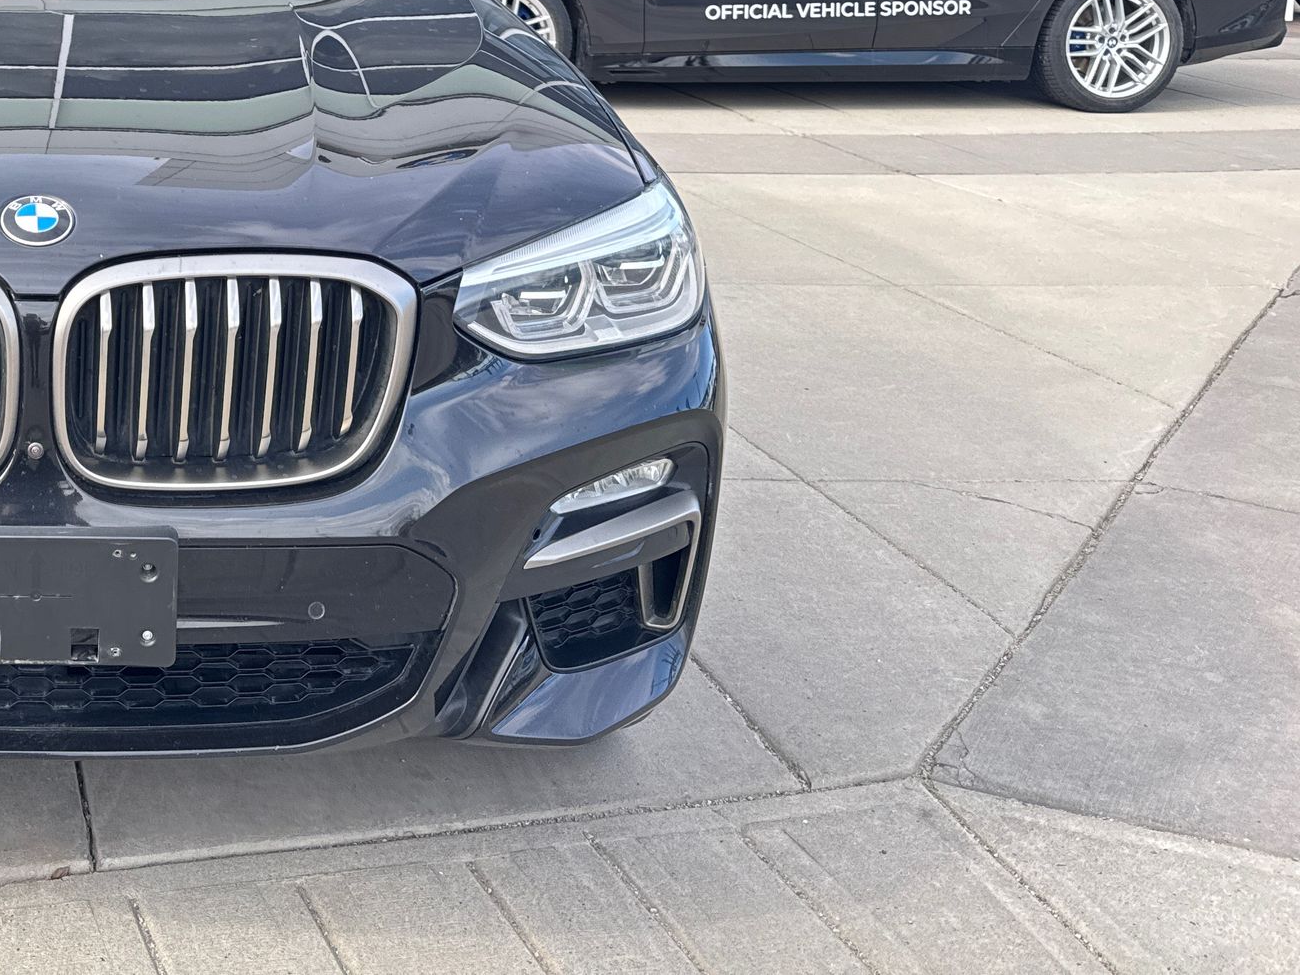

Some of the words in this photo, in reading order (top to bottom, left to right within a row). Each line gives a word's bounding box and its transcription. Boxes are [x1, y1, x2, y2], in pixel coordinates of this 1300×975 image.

[704, 3, 793, 21] OFFICIAL
[796, 1, 876, 19] VEHICLE
[879, 0, 972, 17] SPONSOR
[8, 195, 66, 211] BMW
